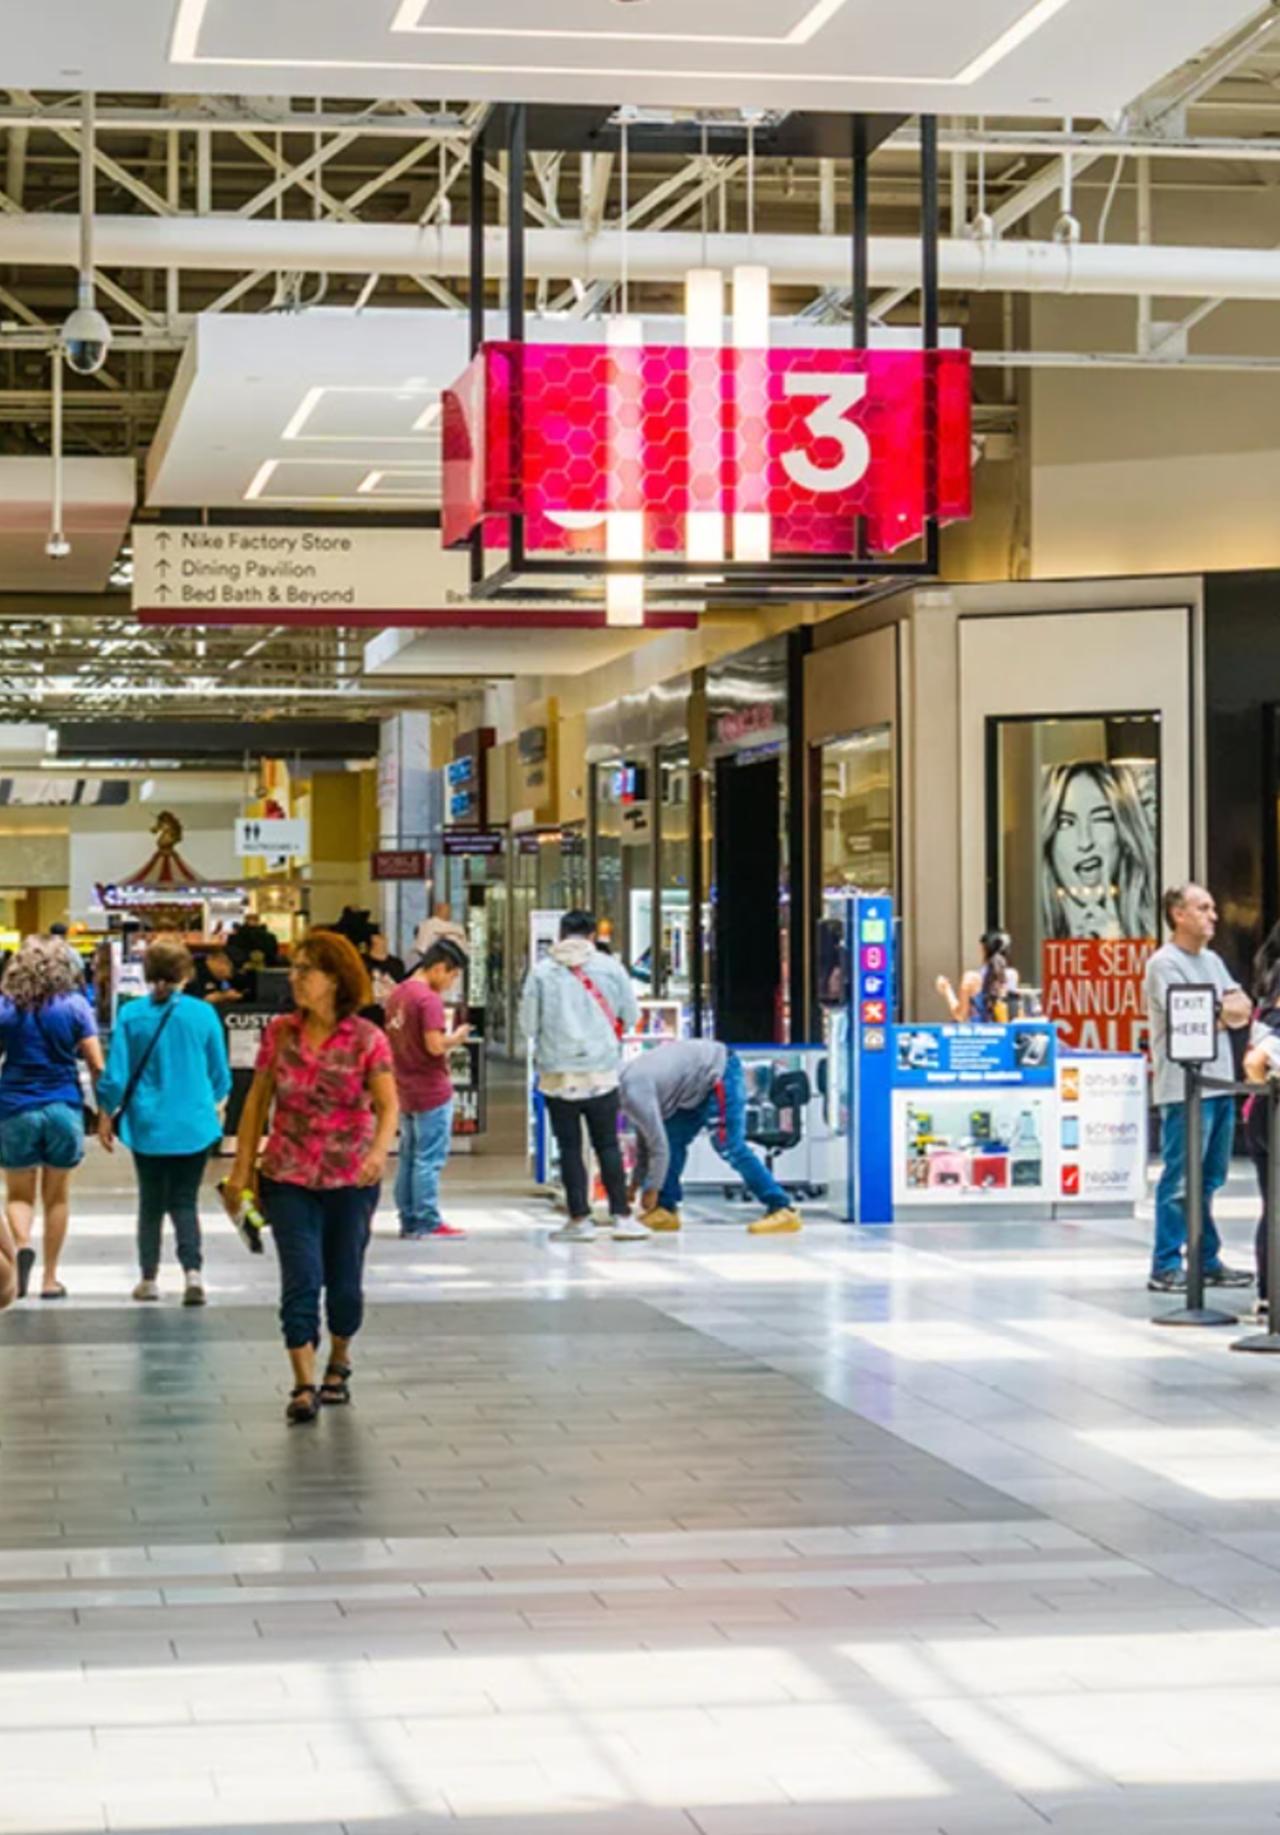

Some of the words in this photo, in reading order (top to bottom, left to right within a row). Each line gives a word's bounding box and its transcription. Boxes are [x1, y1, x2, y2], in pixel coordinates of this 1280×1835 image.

[779, 372, 871, 493] 3
[181, 532, 223, 550] Nike
[229, 532, 297, 554] Factory
[302, 533, 351, 550] Store
[181, 559, 241, 581] Dining
[246, 559, 316, 577] Pavilion
[181, 585, 216, 602] Bed
[222, 585, 262, 602] Bath
[267, 586, 281, 602] &
[287, 586, 355, 605] Beyond
[1045, 943, 1092, 976] THE
[1173, 996, 1205, 1010] EXIT
[1171, 1022, 1208, 1036] HERE
